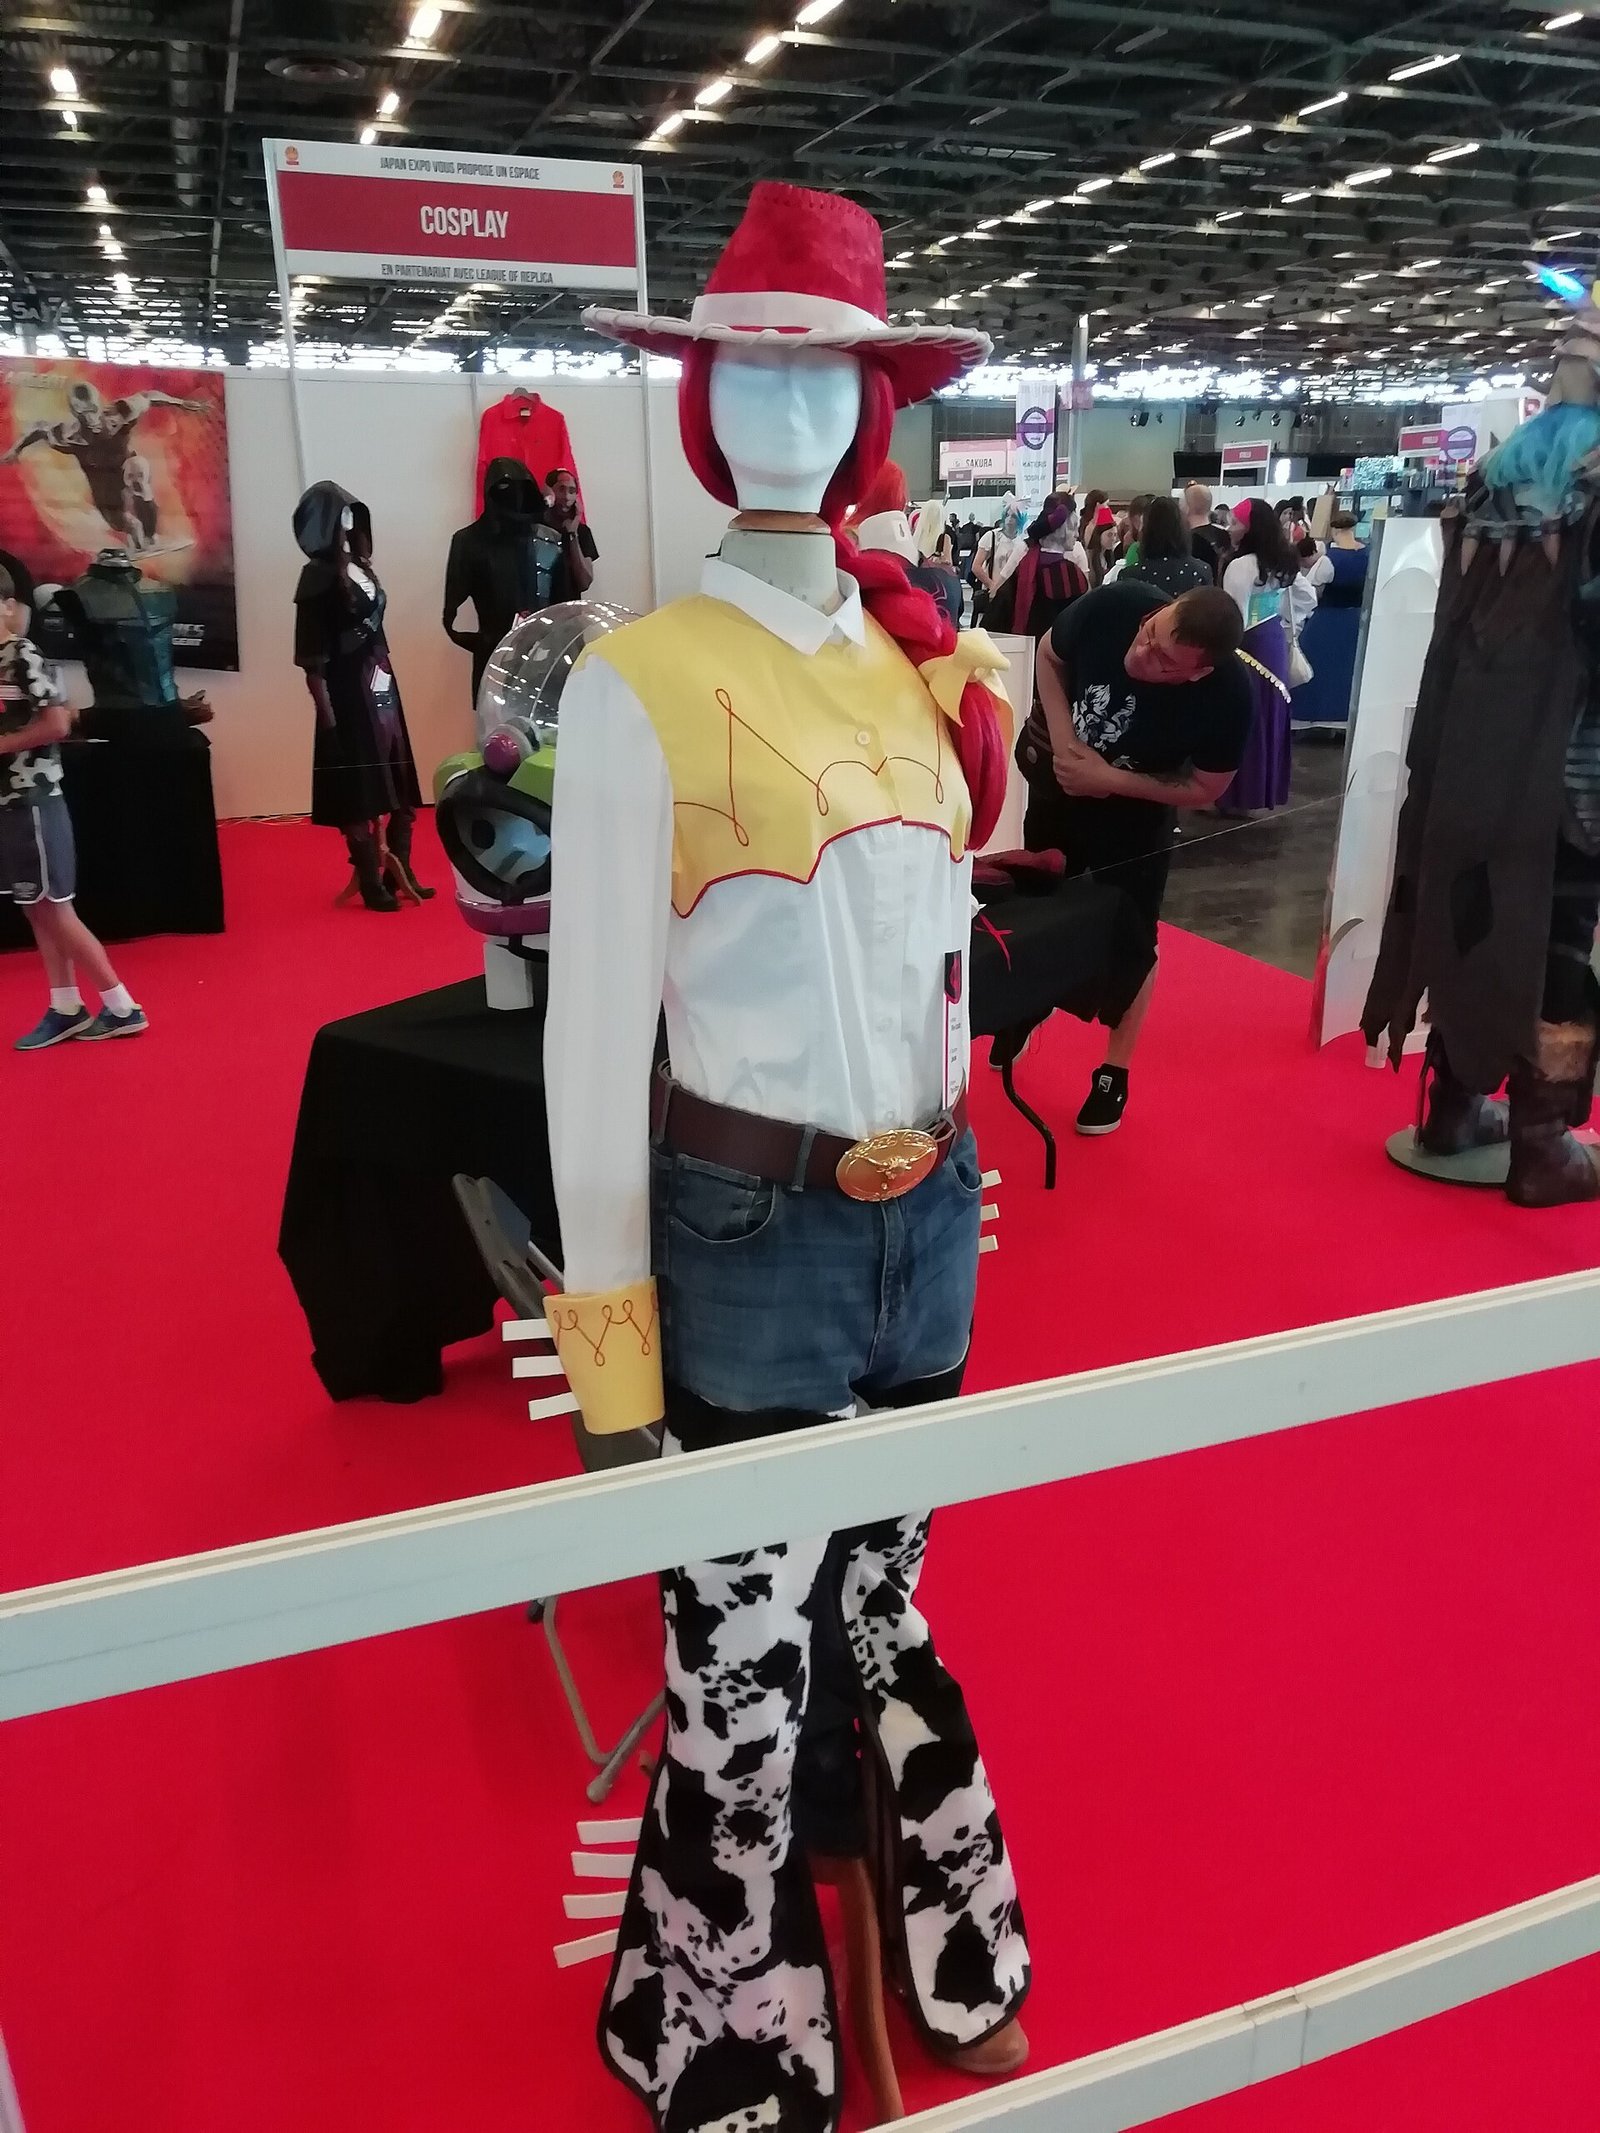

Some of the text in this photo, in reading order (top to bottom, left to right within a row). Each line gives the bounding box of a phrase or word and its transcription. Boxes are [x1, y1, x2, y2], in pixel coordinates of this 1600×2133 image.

[380, 157, 540, 180] JAPAN EXPO VOUS PROPOSE UN ESPACE
[420, 205, 509, 239] COSPLAY
[381, 263, 554, 284] EN PARTENARIAT AVEC LEAGUE OF REPLICA
[965, 458, 993, 468] SAKURA
